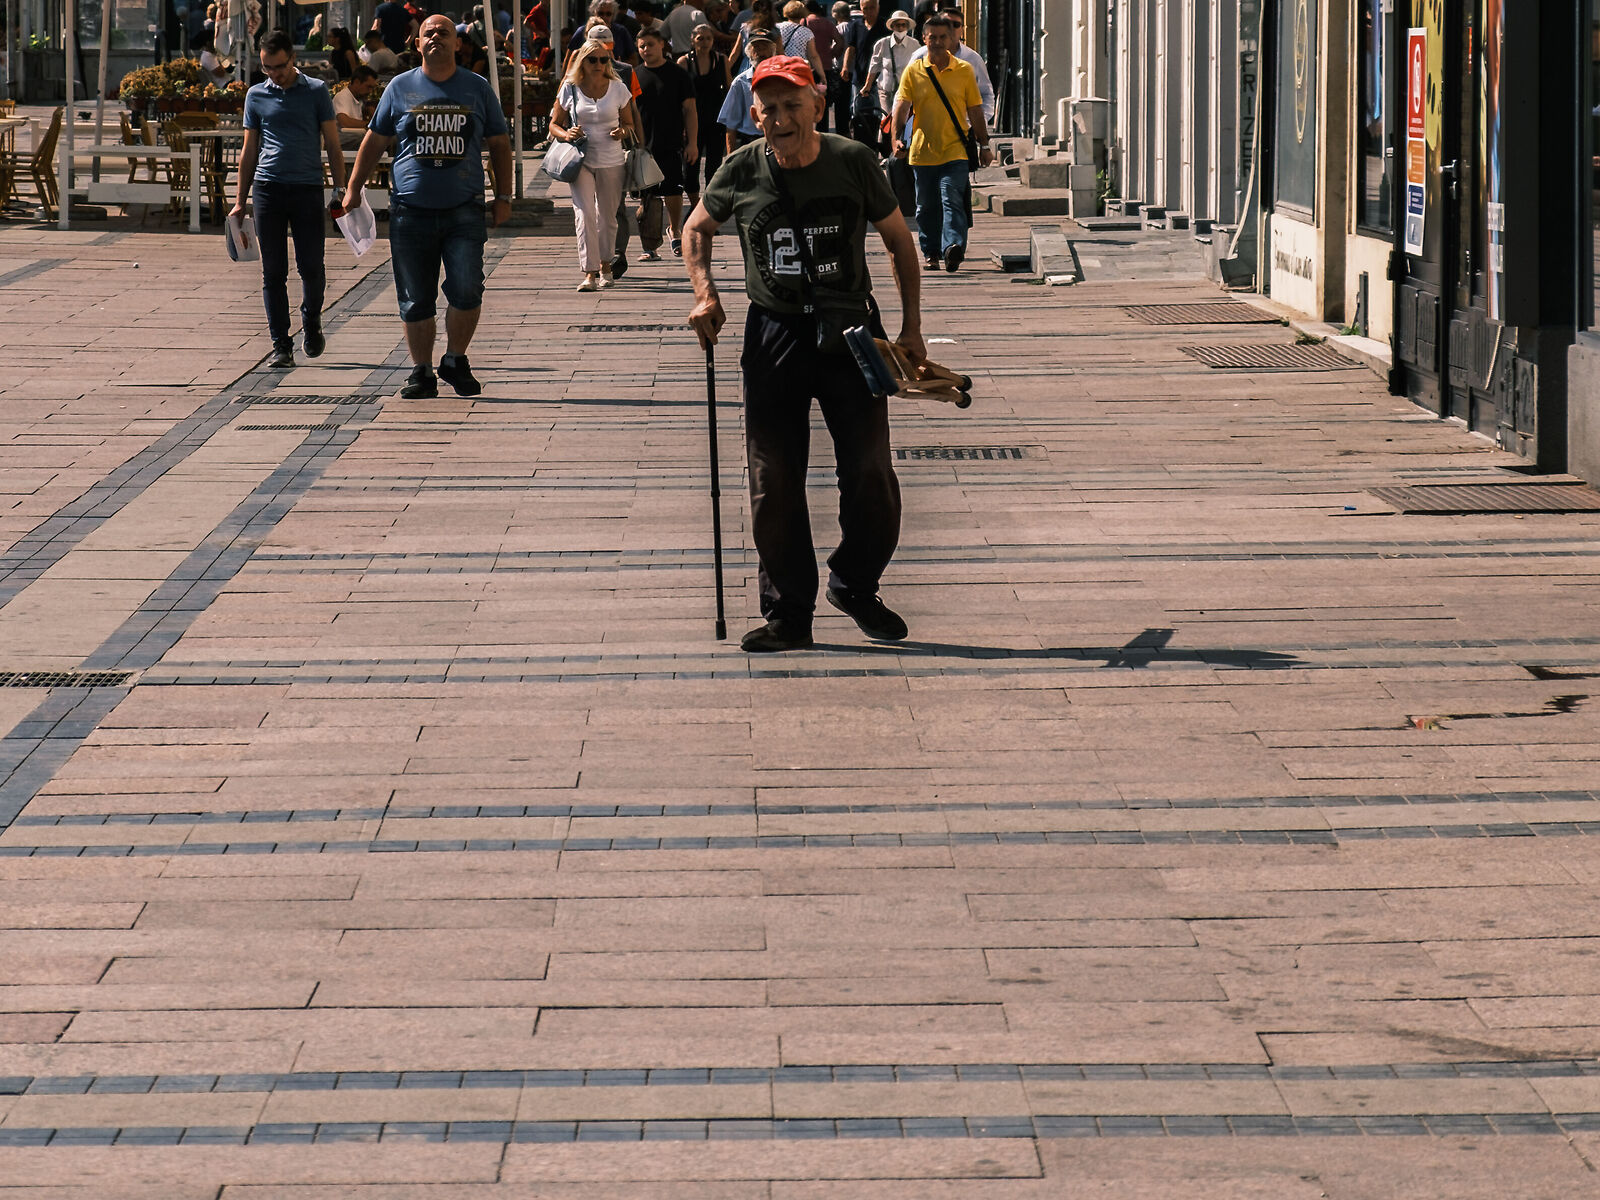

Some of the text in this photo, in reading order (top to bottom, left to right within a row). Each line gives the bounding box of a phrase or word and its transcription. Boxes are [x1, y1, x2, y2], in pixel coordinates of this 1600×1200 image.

[416, 113, 467, 132] CHAMP
[415, 135, 465, 155] BRAND
[803, 225, 839, 235] PERFECT
